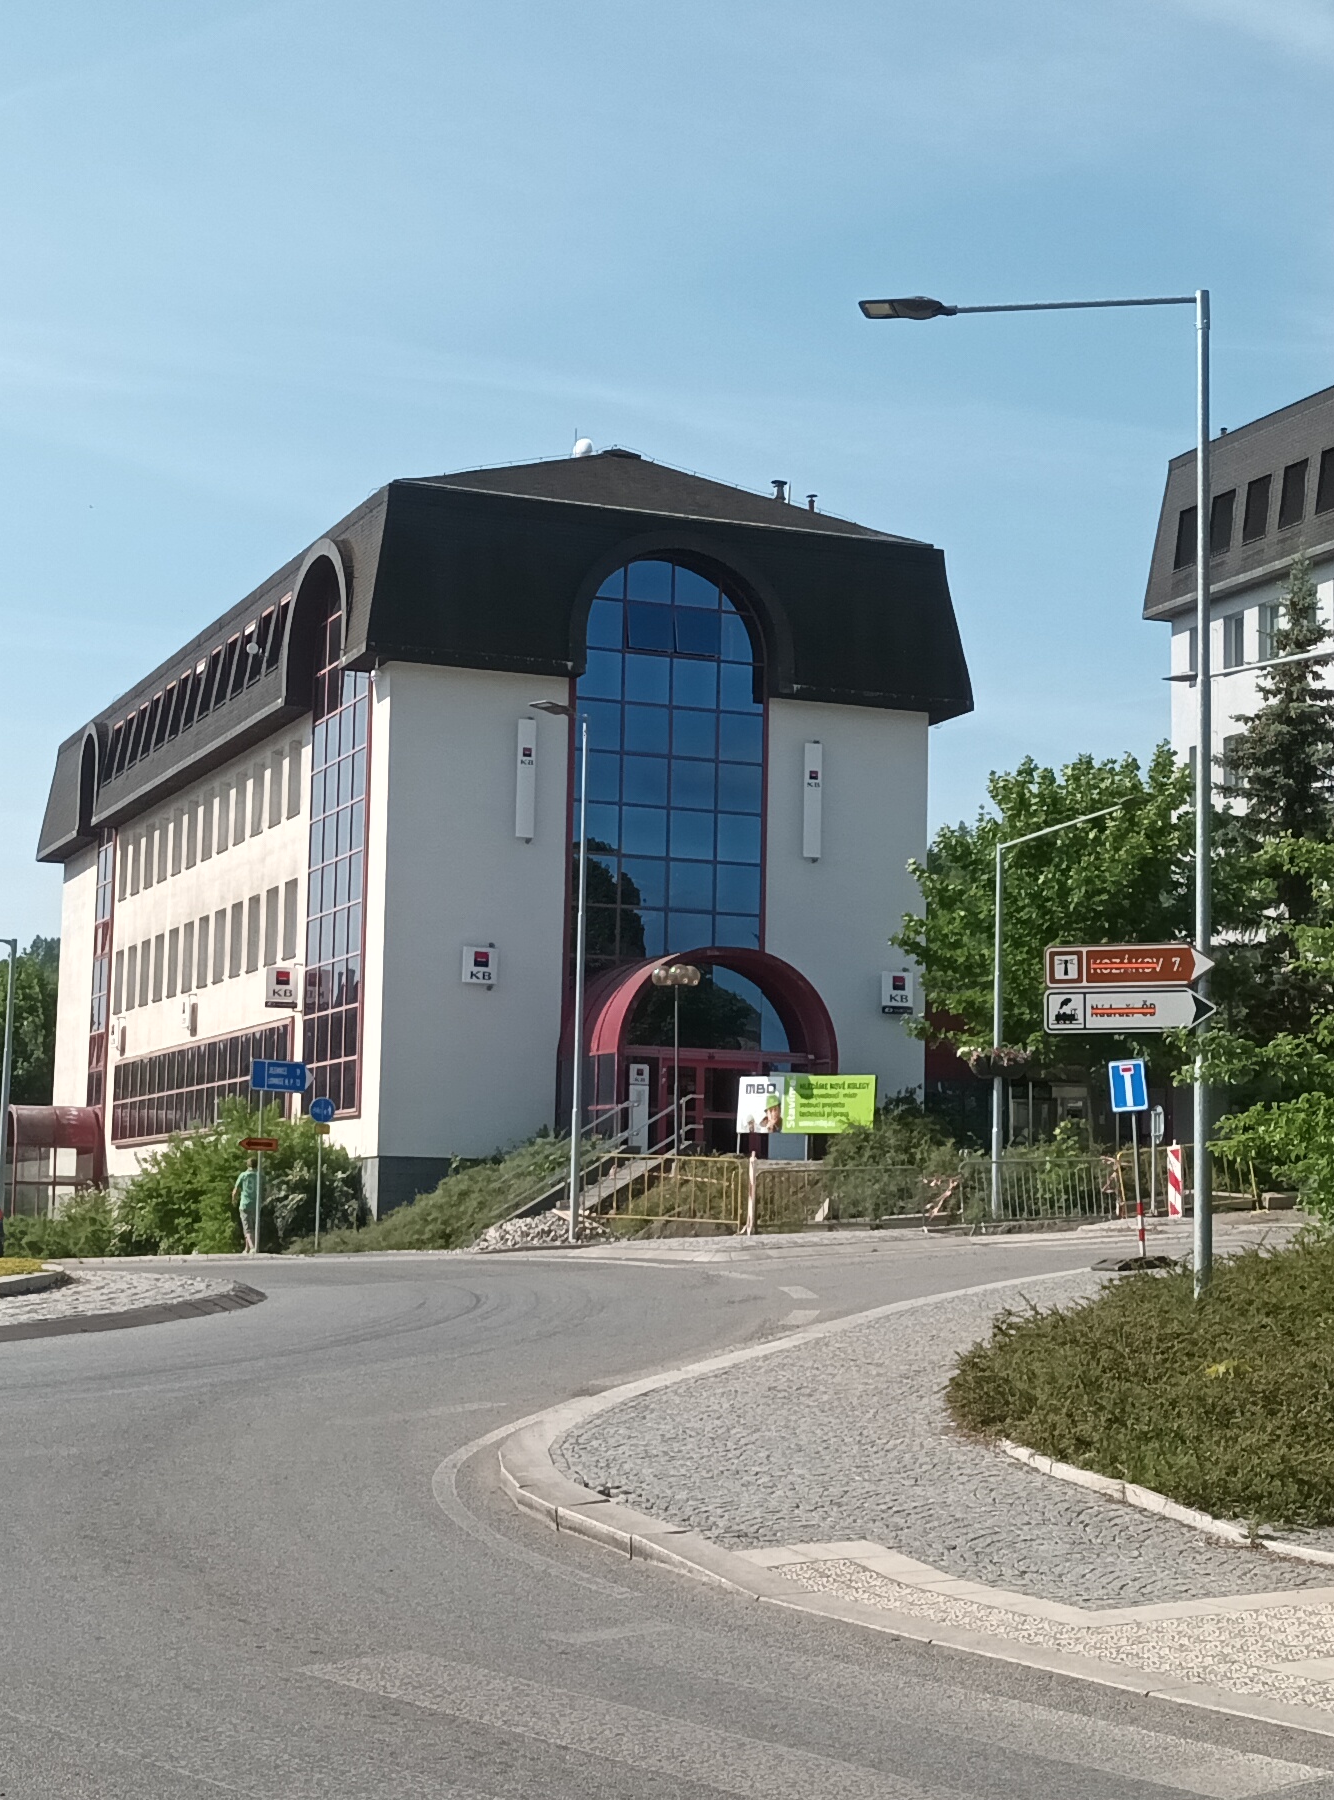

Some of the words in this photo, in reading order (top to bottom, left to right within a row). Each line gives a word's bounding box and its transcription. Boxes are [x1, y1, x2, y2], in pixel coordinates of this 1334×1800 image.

[470, 971, 492, 981] KB
[272, 988, 293, 998] KB
[889, 994, 909, 1004] KB
